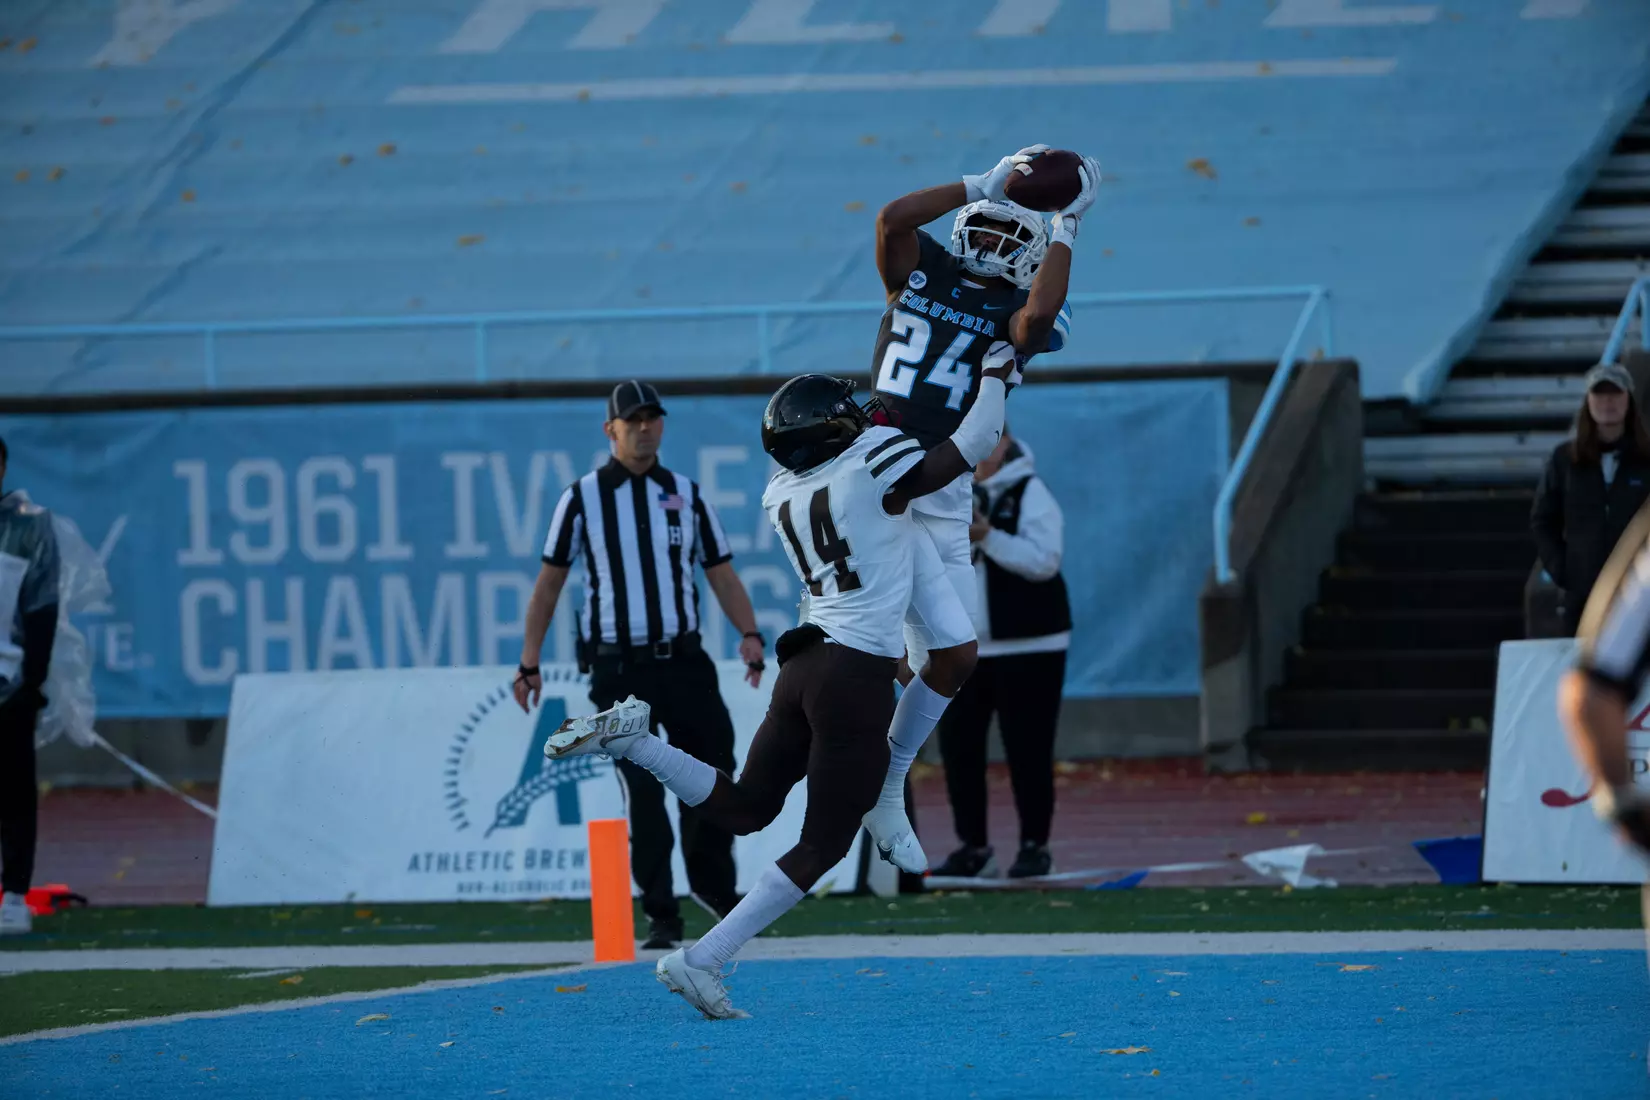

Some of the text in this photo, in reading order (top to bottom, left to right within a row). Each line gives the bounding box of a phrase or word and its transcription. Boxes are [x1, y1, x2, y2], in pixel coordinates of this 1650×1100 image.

[899, 289, 996, 338] COLUMBIA
[876, 308, 977, 412] 24
[173, 453, 414, 566] 1961
[669, 525, 682, 546] H
[778, 484, 863, 597] 14
[407, 850, 516, 873] ATHLETIC
